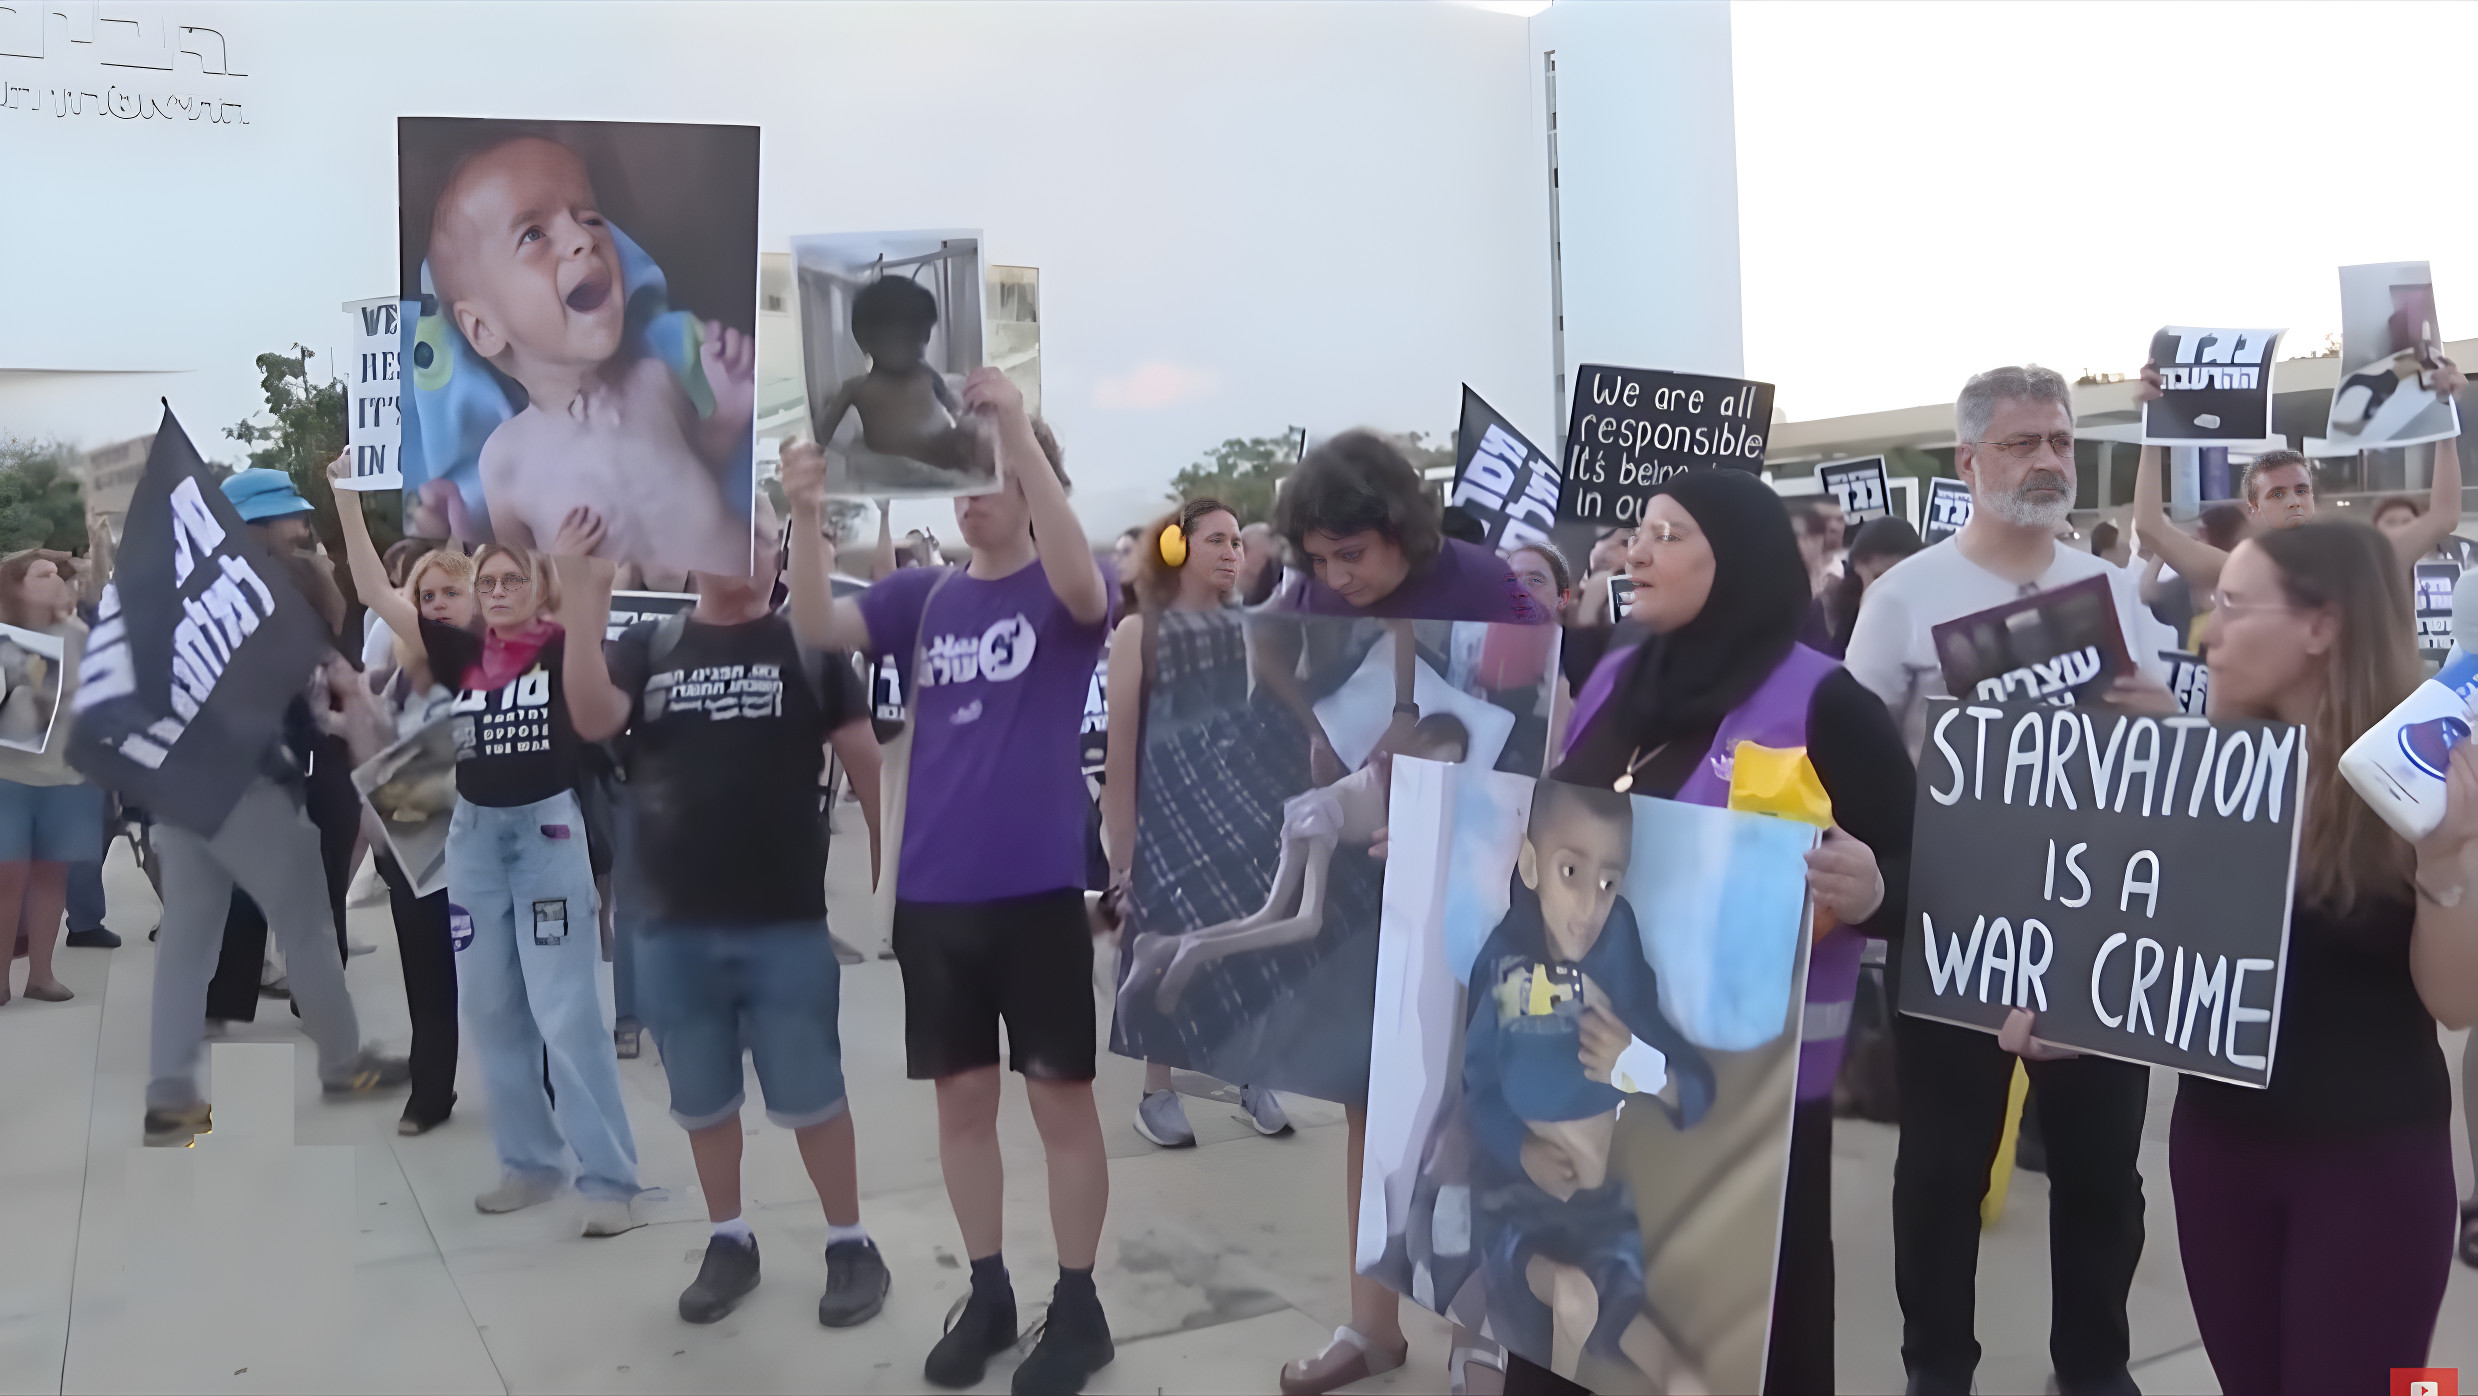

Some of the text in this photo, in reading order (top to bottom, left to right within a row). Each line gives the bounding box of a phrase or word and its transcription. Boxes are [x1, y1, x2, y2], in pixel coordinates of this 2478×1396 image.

[1593, 373, 1756, 420] We are all
[357, 444, 386, 478] IN
[1569, 444, 1606, 483] It's
[1929, 706, 2296, 823] STARVATION
[2043, 838, 2160, 919] IS A
[1922, 911, 2275, 1071] WAR CRIME
